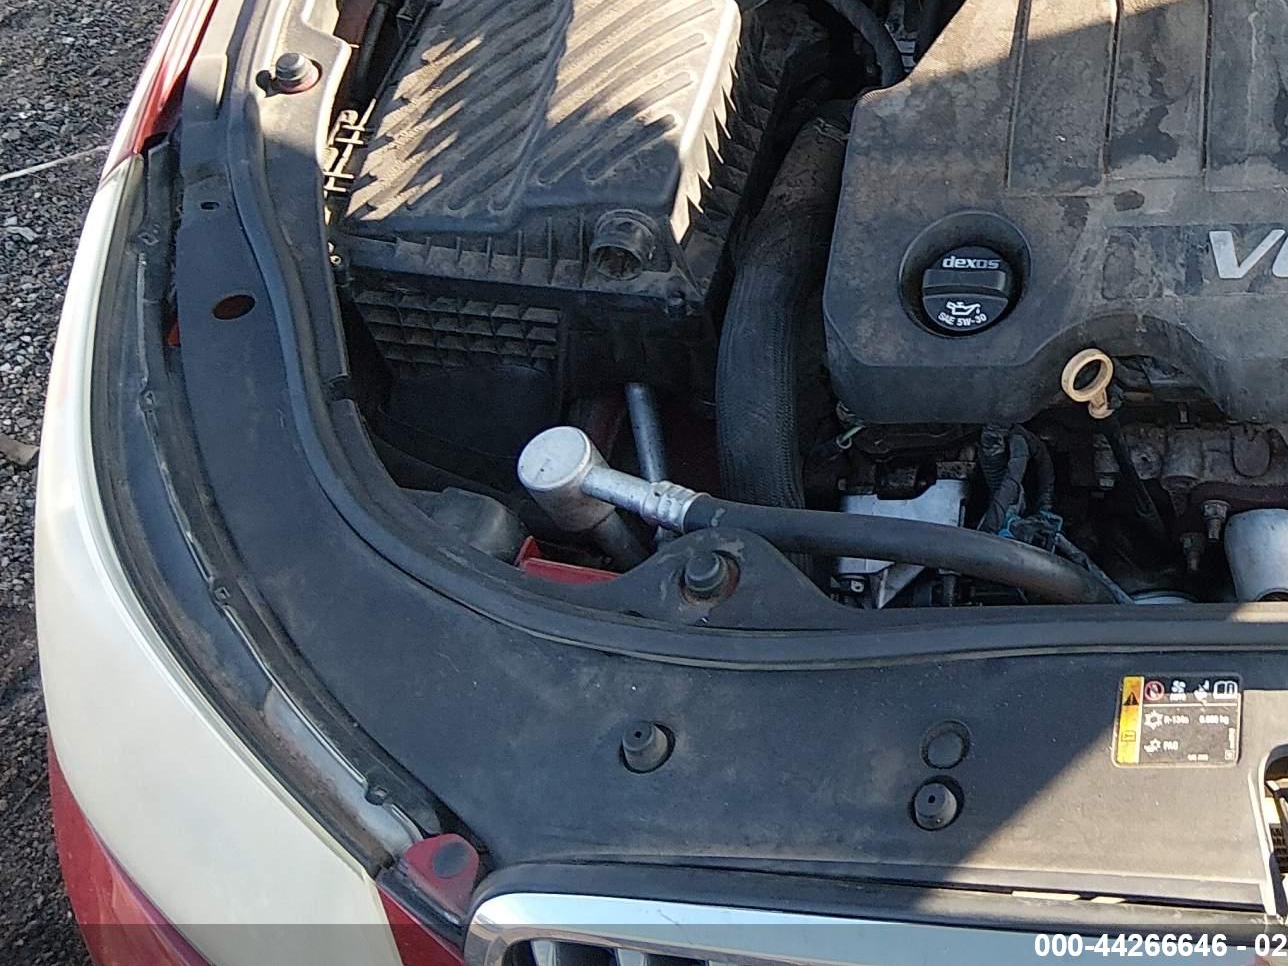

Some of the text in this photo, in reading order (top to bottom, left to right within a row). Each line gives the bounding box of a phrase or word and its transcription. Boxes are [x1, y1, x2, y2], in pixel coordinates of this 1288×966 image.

[942, 255, 1002, 270] dexos
[938, 311, 988, 327] SAE 5W-30
